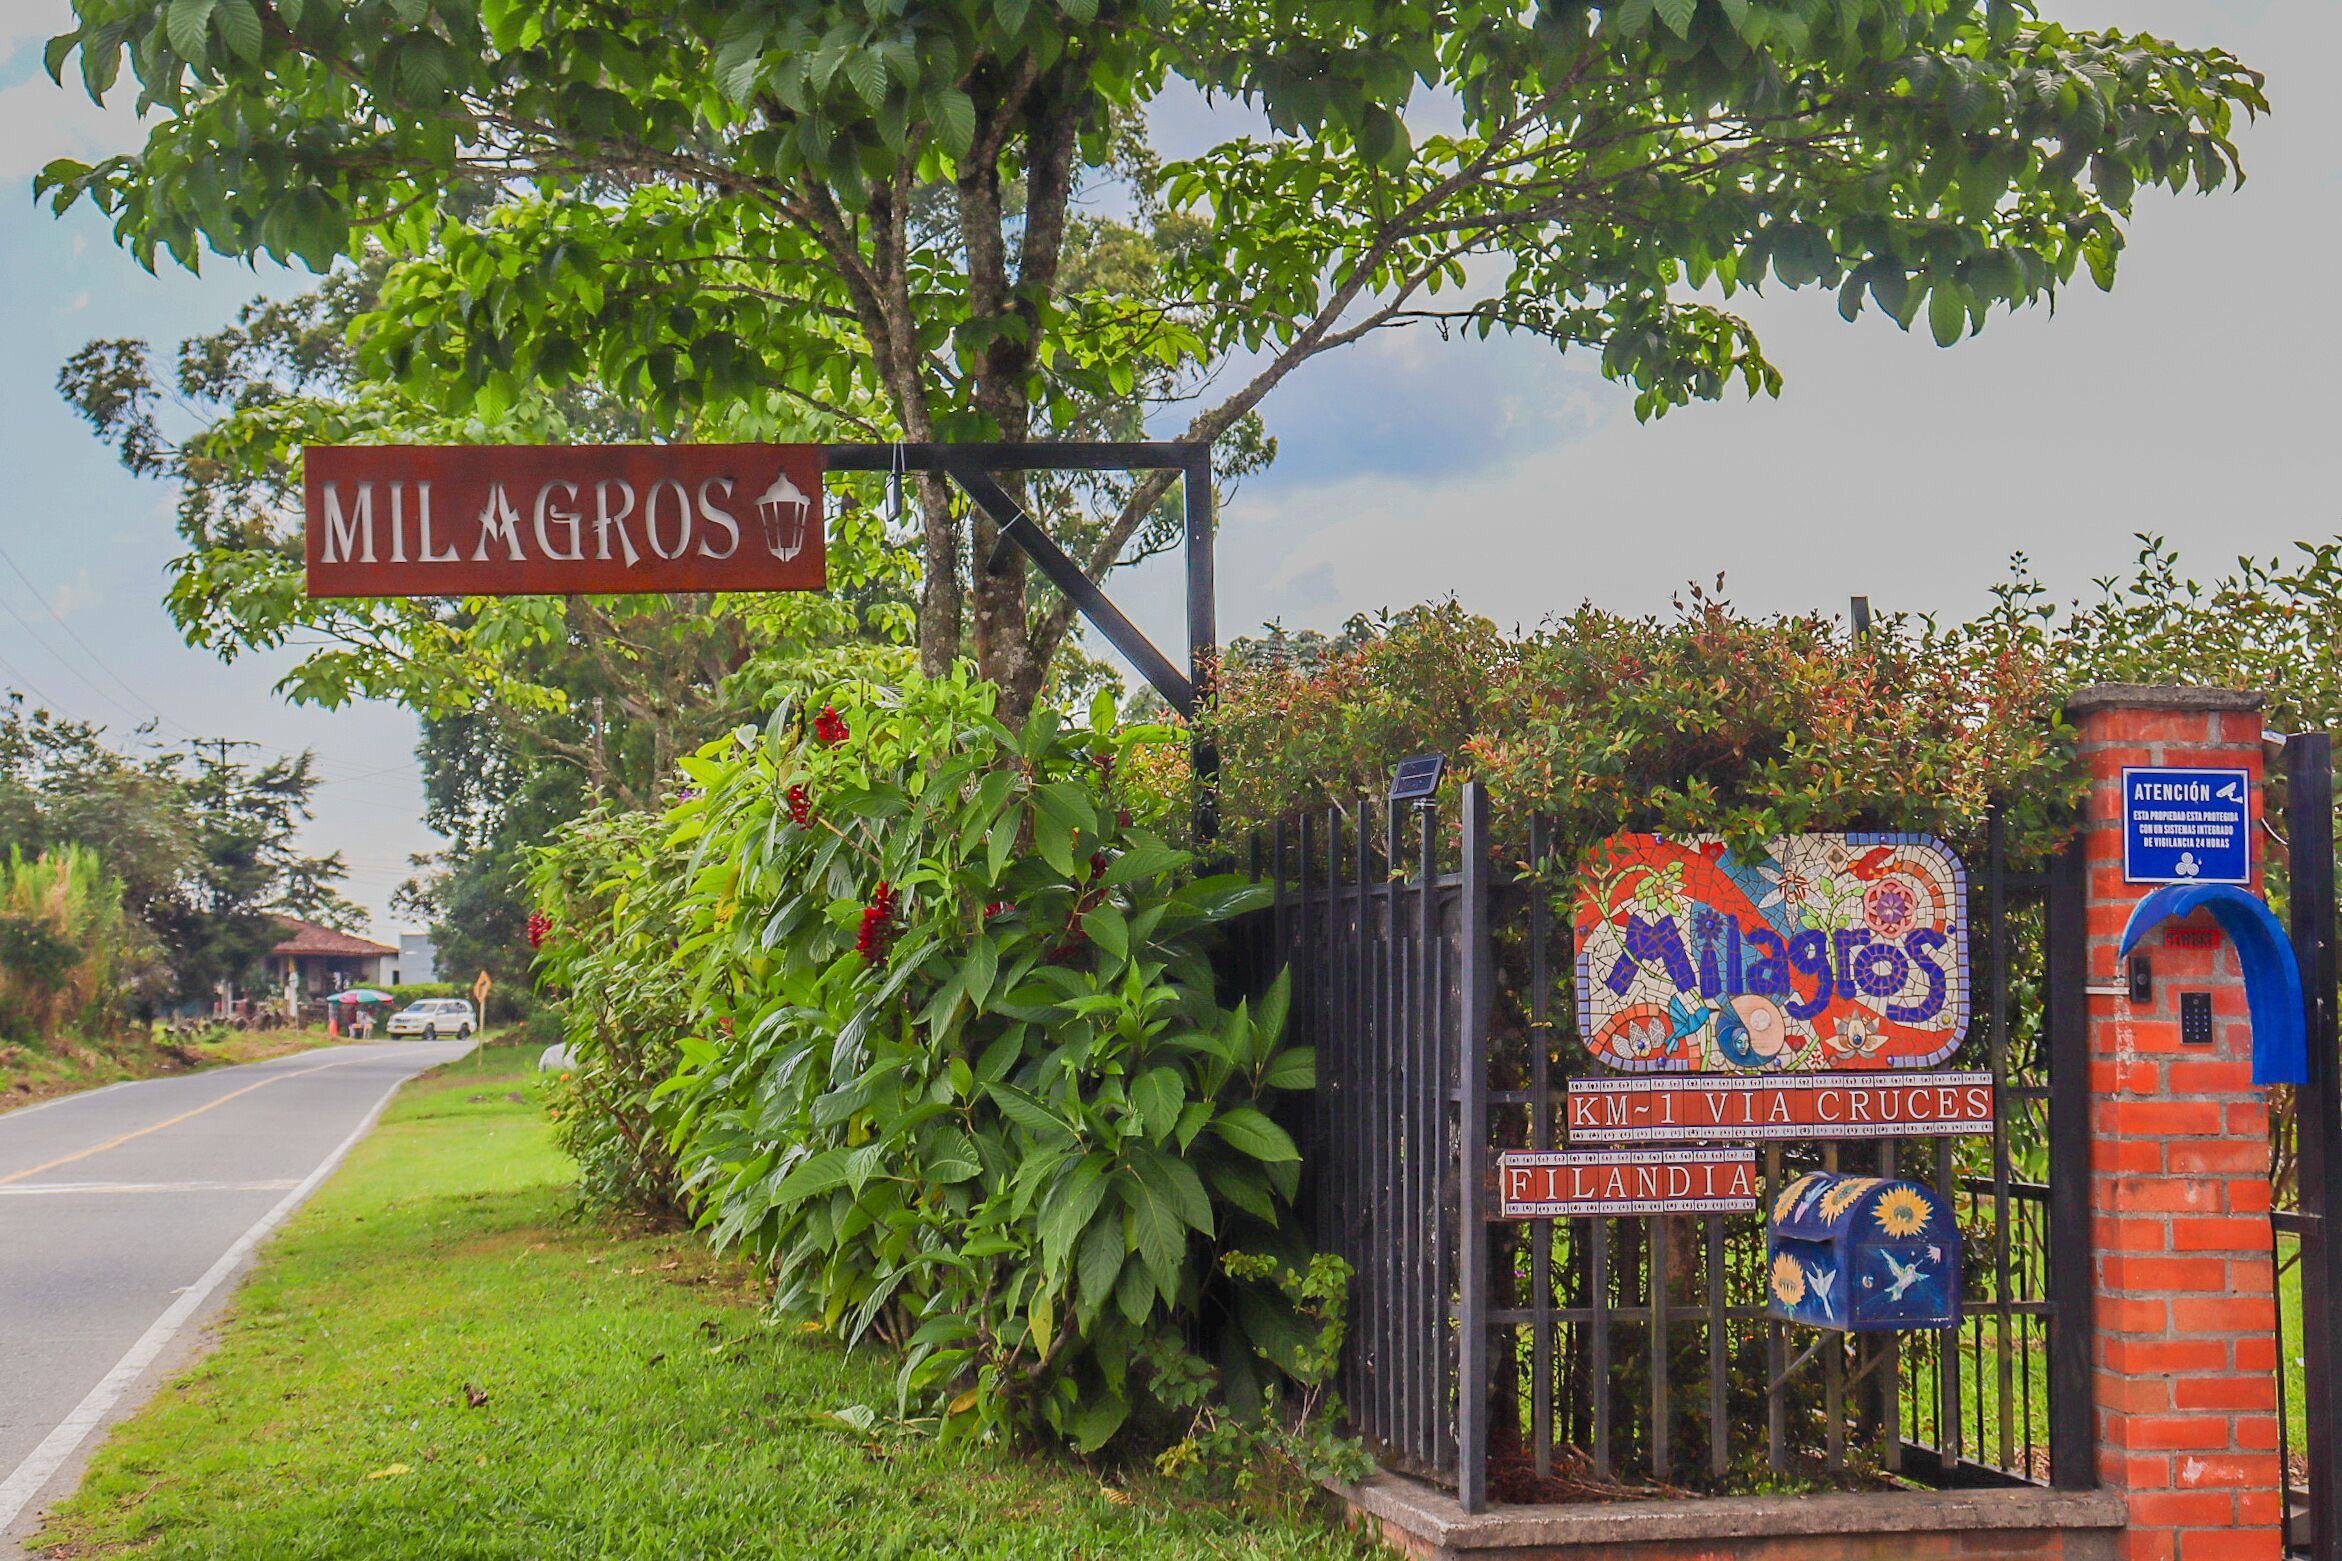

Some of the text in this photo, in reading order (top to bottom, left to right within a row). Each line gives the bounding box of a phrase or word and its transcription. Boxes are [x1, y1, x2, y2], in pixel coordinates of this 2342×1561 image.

[320, 475, 741, 567] MILAGROS
[2134, 781, 2210, 801] ATENCIÓN
[2133, 810, 2239, 822] ESTA PROPIEDAD ESTA PROTEGIDA
[2139, 824, 2153, 834] CON
[2197, 825, 2234, 835] INTEGRADO
[2143, 837, 2230, 848] DE VIGILANCIA 24 HORAS
[1605, 910, 1948, 1024] Milagros
[1705, 1091, 1791, 1124] VIA
[1817, 1088, 1990, 1121] CRUCES
[1509, 1164, 1751, 1200] FILANDIA
